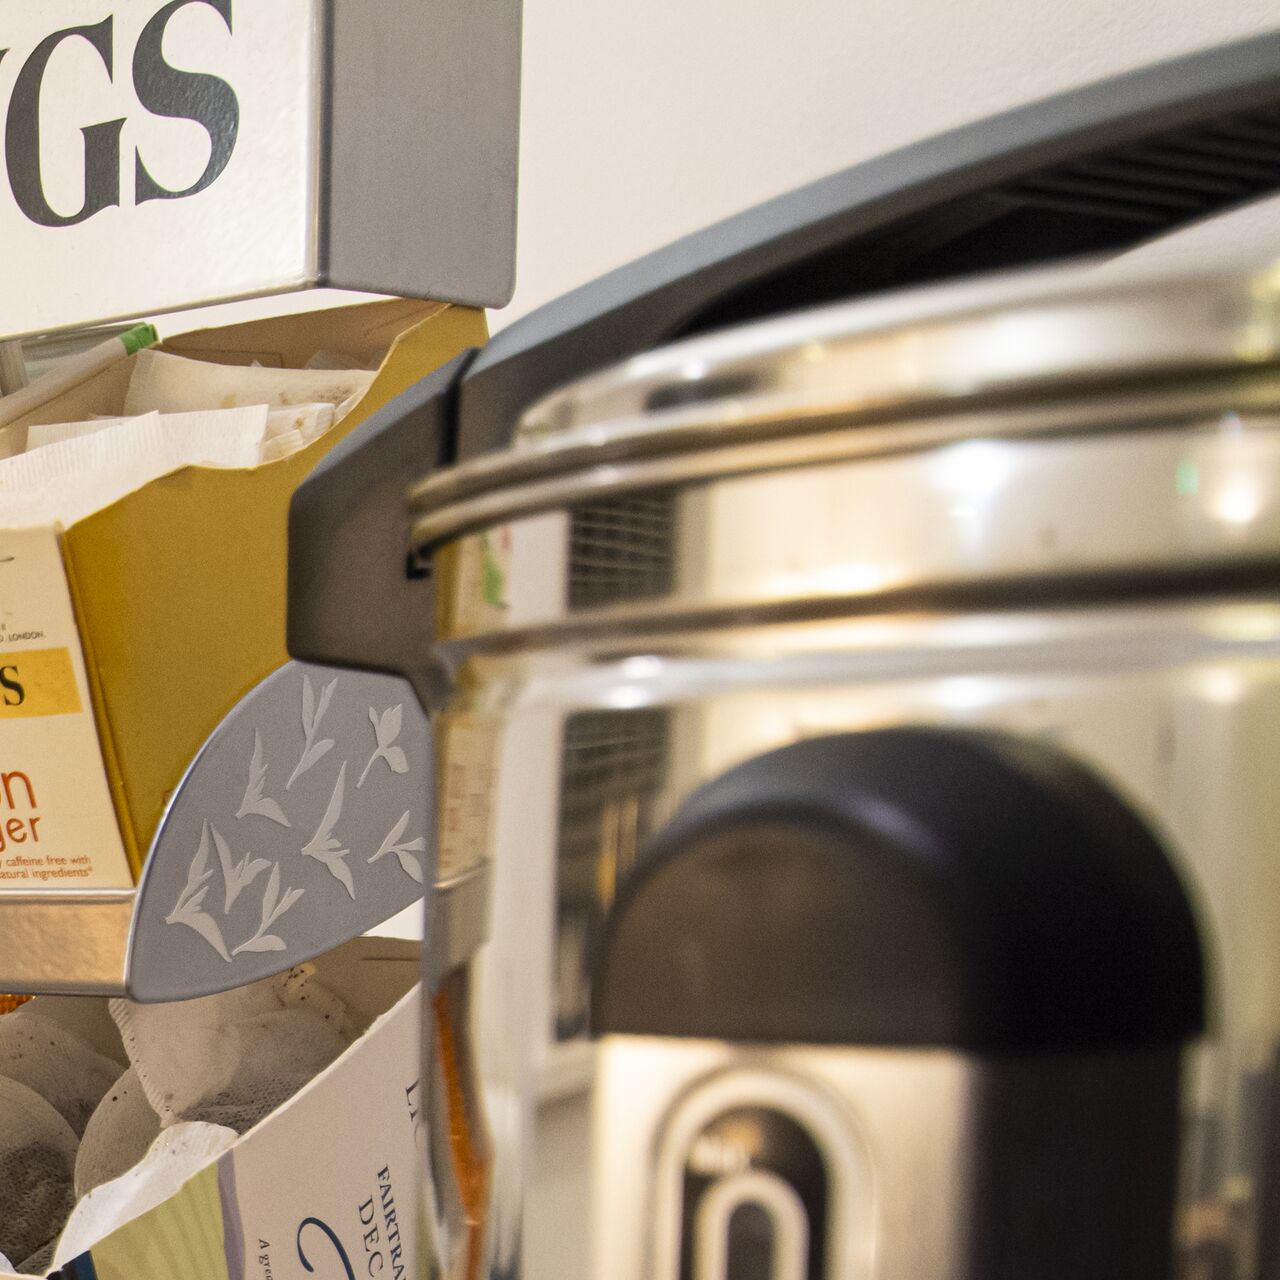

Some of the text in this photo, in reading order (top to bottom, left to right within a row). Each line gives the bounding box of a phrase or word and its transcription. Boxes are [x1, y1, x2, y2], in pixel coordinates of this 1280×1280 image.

[6, 855, 44, 867] caffeine
[46, 855, 67, 866] free
[71, 855, 91, 865] with
[258, 1238, 271, 1250] A
